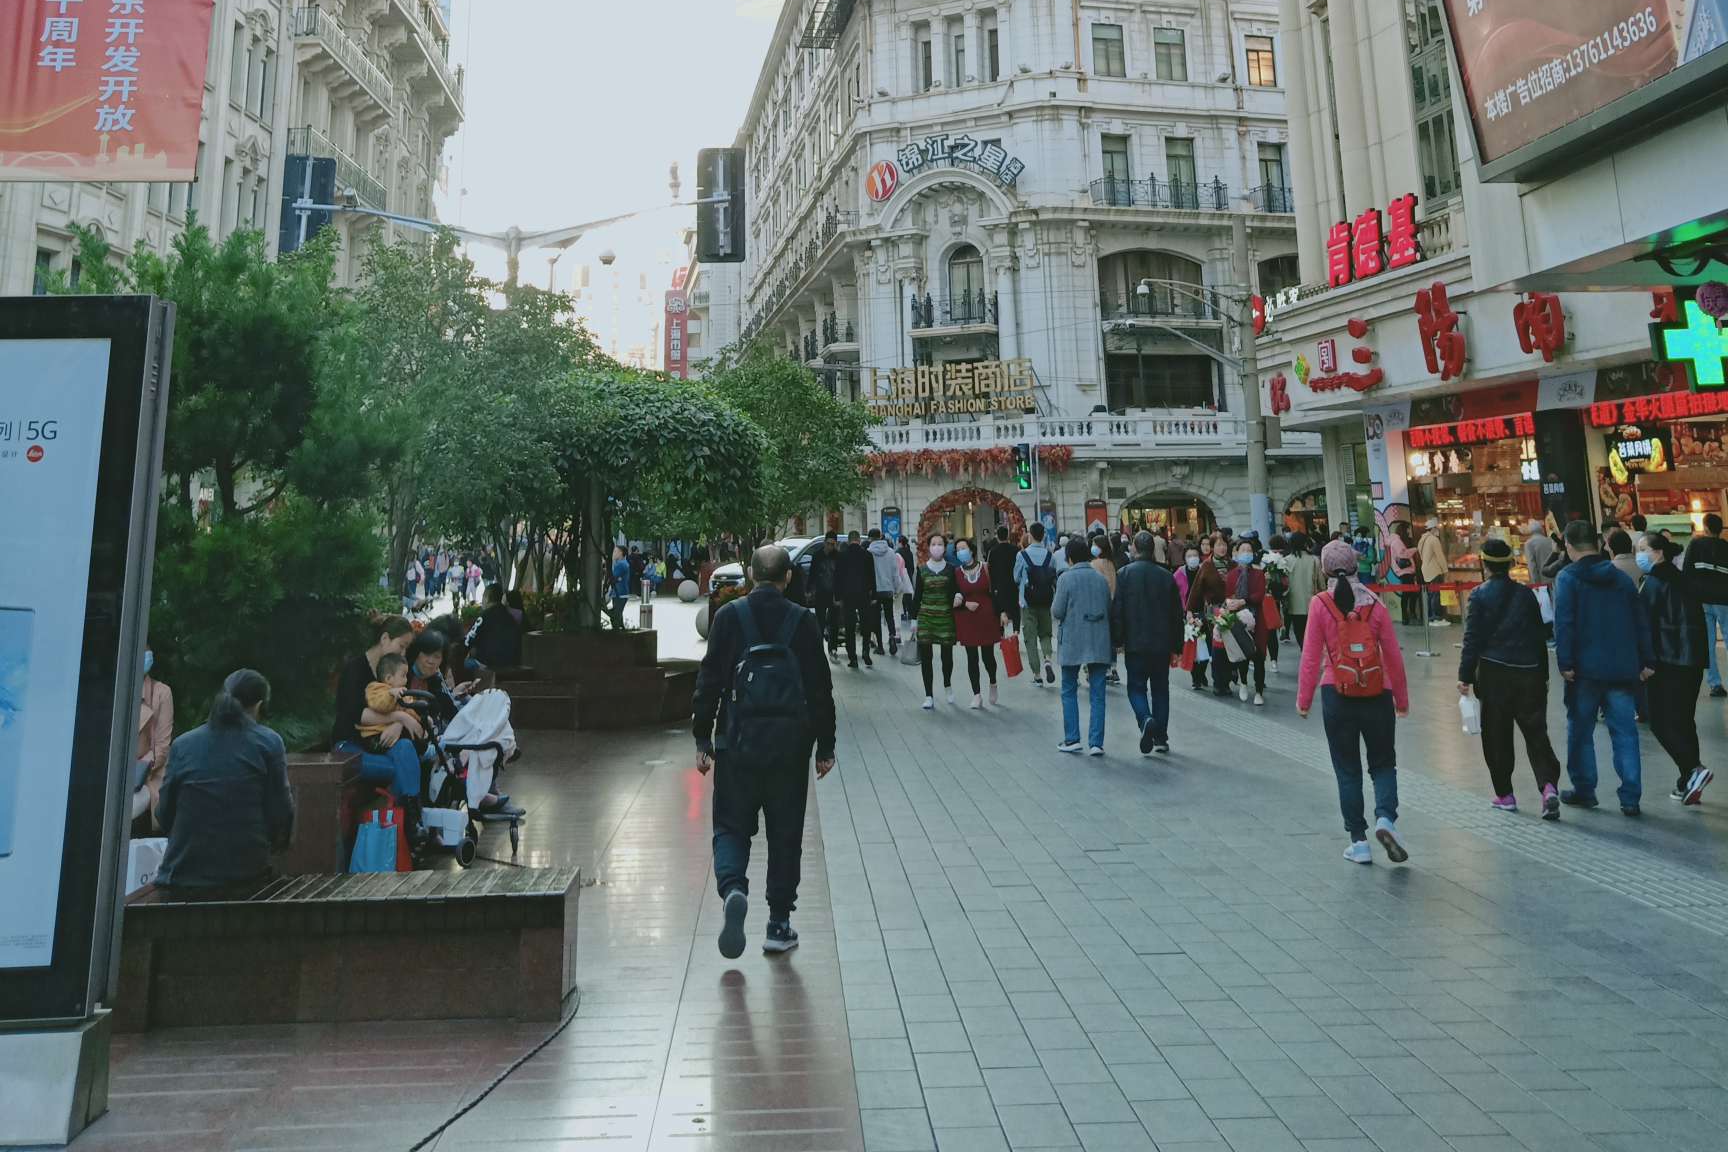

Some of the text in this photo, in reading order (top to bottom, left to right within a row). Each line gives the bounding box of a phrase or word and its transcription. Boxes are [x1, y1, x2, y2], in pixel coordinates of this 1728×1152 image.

[897, 134, 1008, 176] 锦江之星
[1327, 193, 1419, 289] 肯德基
[866, 358, 1035, 400] 上海时装商店
[930, 397, 985, 415] FASHION
[990, 395, 1035, 410] STORE
[26, 420, 58, 441] 5G
